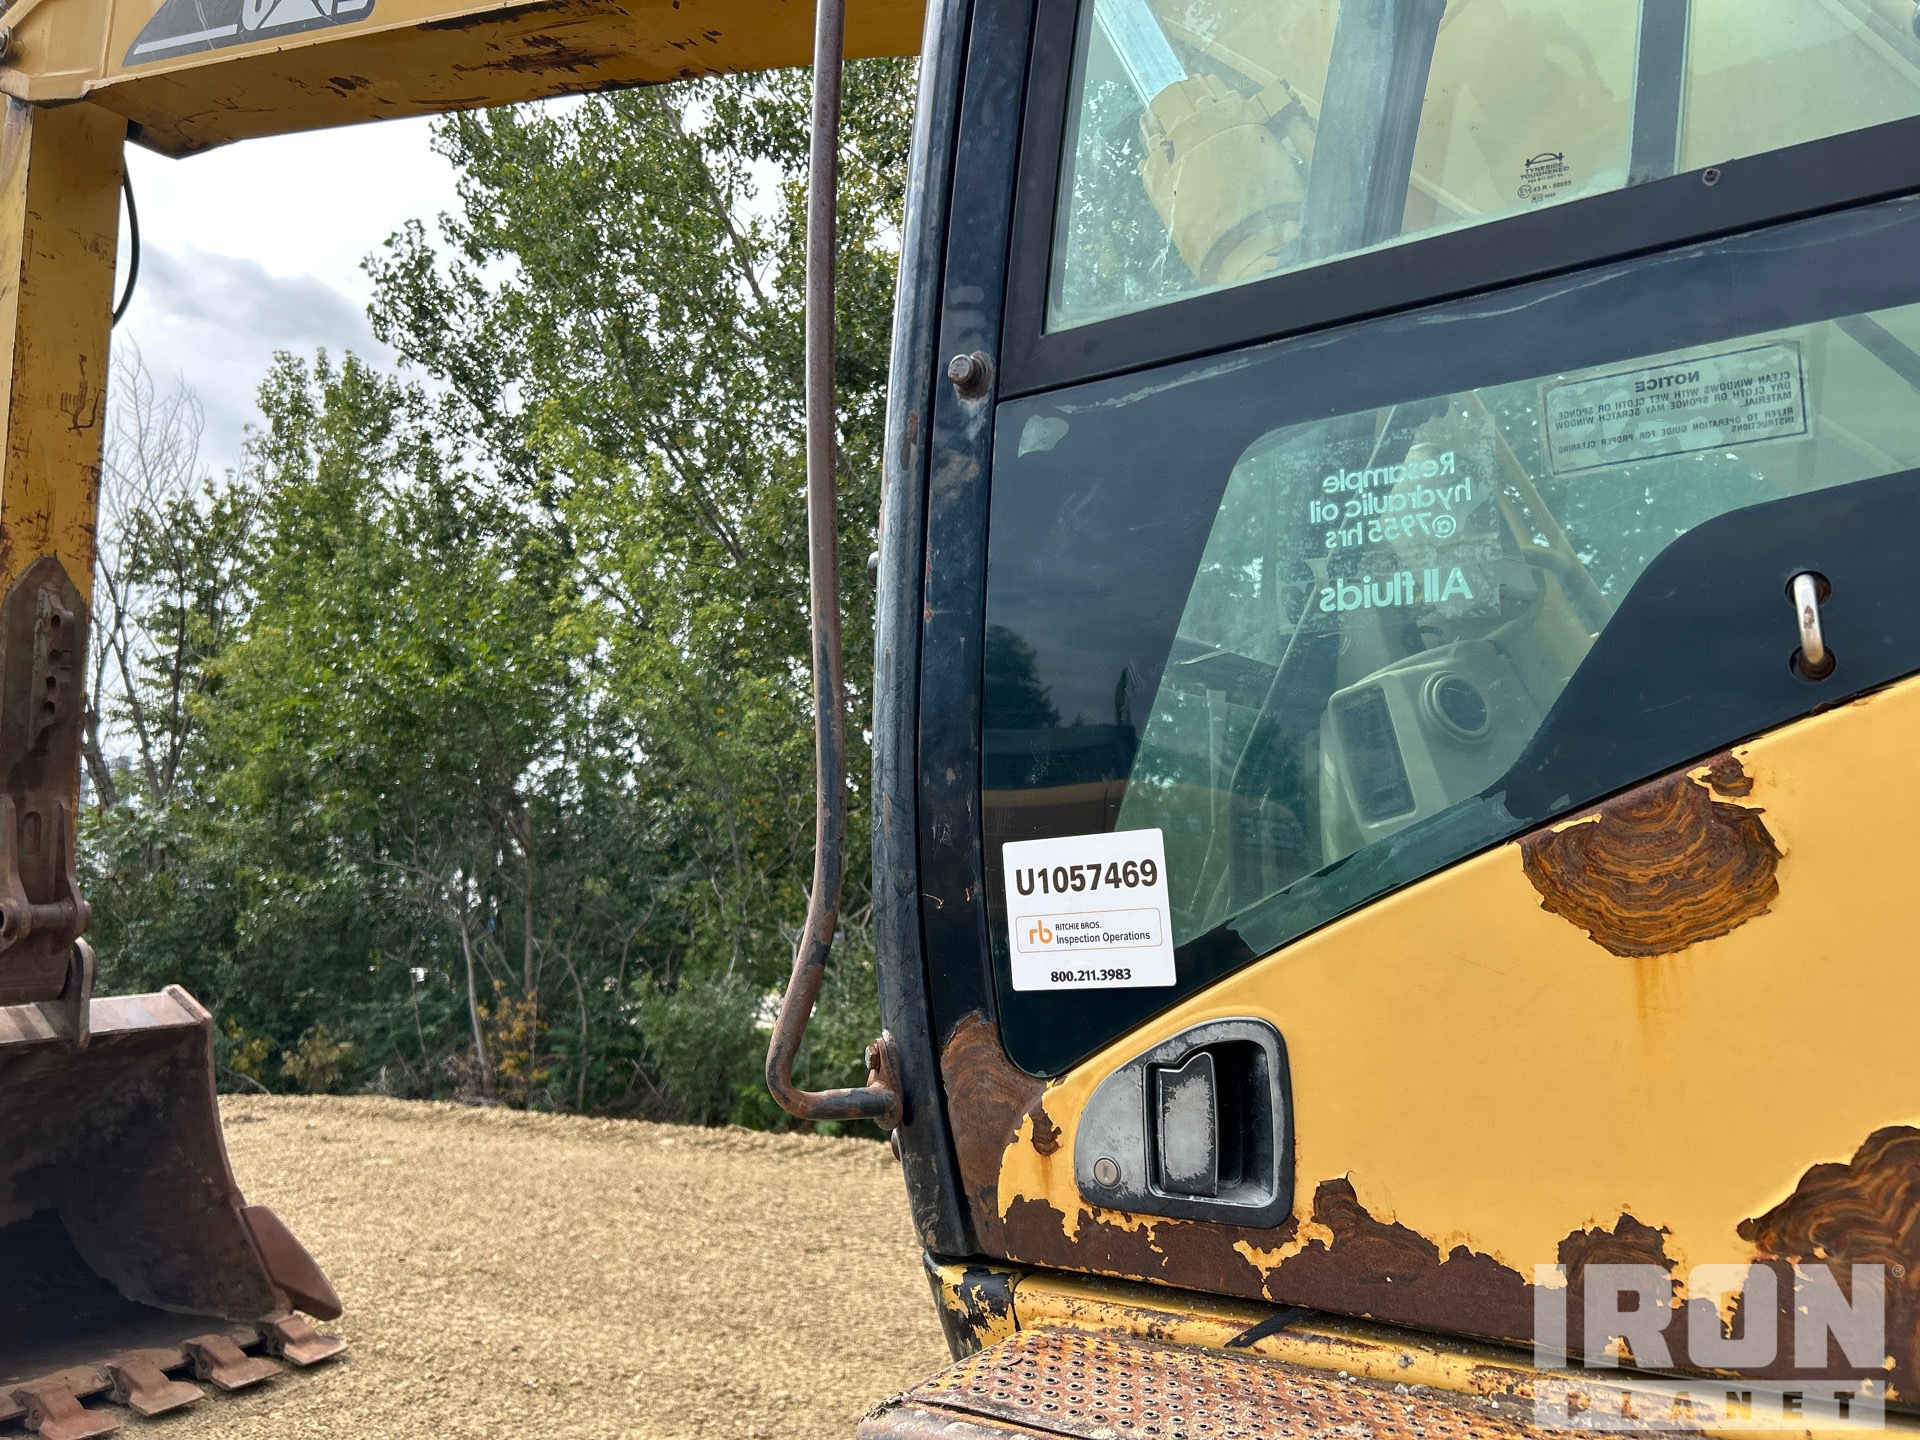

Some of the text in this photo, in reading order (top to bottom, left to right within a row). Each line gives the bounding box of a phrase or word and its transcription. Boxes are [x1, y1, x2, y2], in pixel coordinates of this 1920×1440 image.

[1520, 166, 1570, 180] TOUGHENED
[1525, 162, 1563, 174] TYNESIDE
[1015, 858, 1158, 896] U1057469
[1029, 920, 1053, 945] rb
[1055, 921, 1102, 931] RITCHIE BROS.
[1057, 931, 1150, 946] Inspection Operations
[1051, 968, 1132, 982] 800.211.3983
